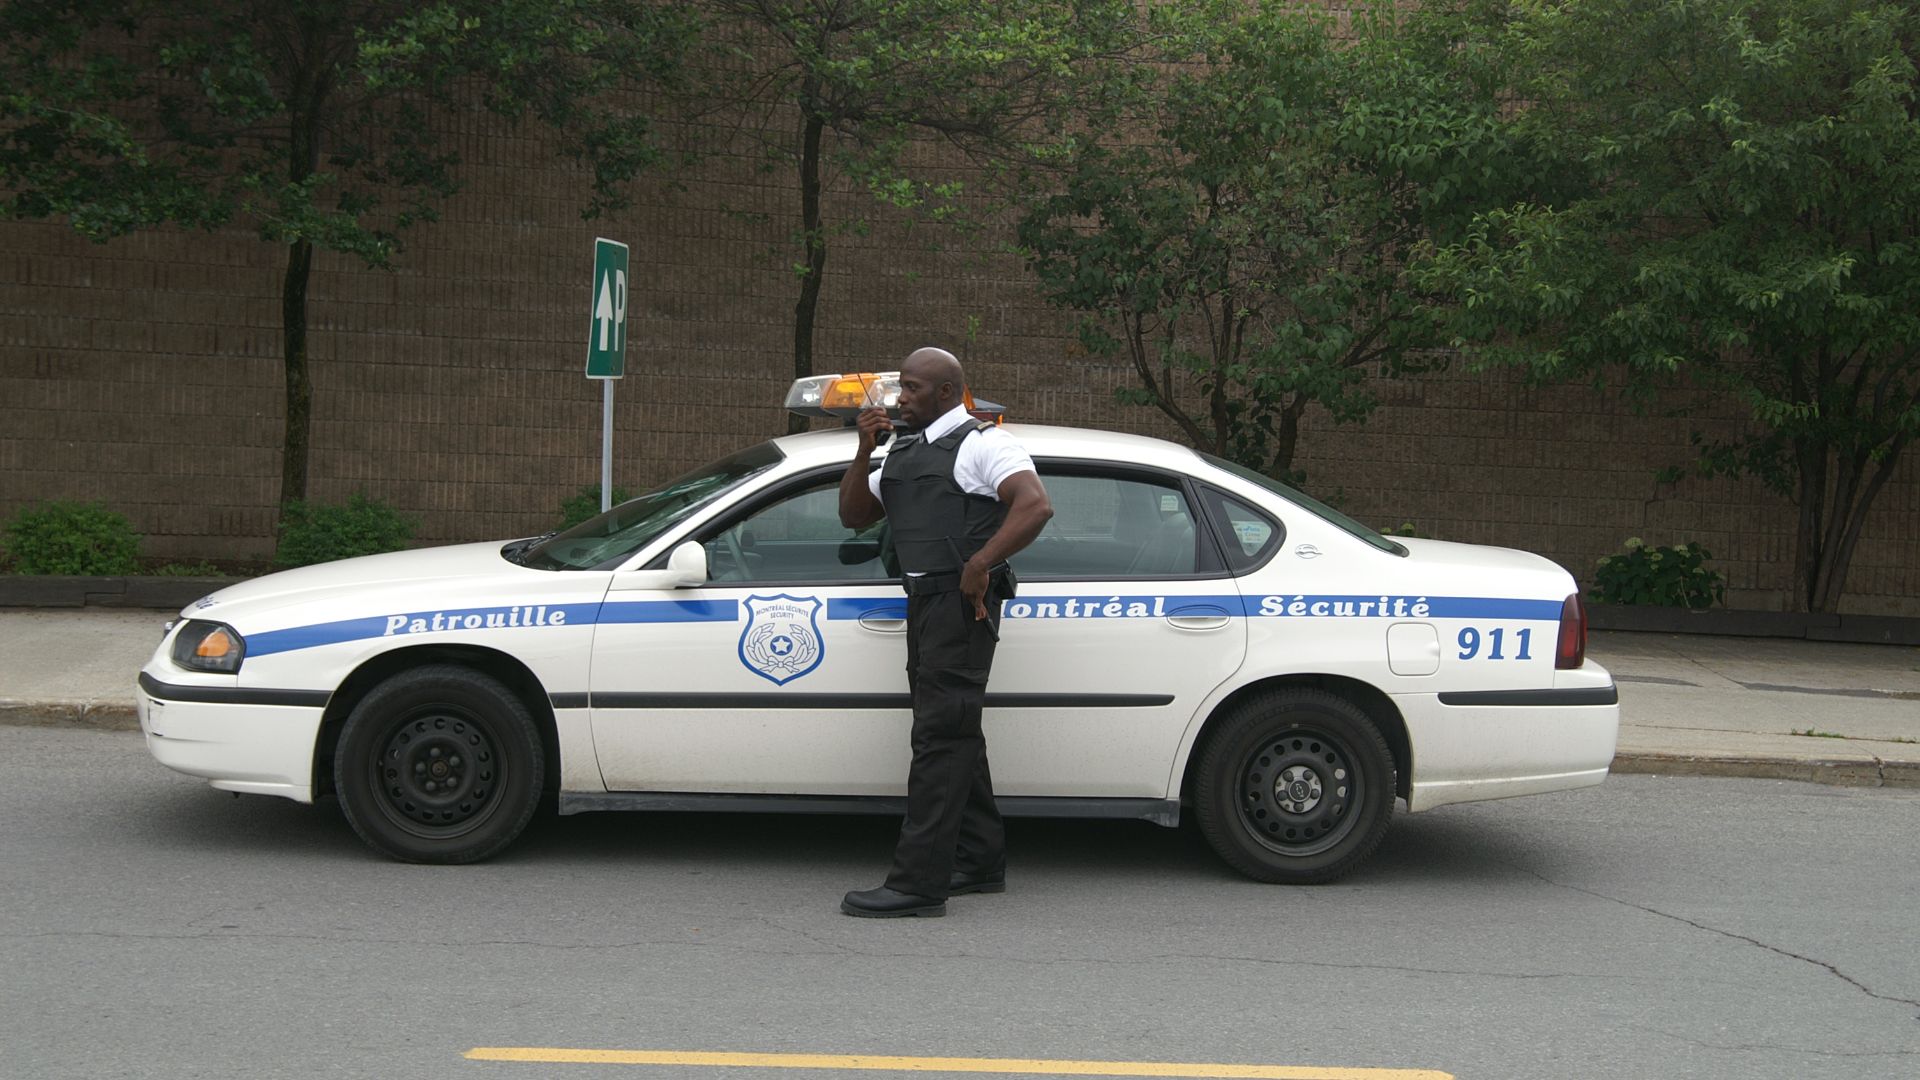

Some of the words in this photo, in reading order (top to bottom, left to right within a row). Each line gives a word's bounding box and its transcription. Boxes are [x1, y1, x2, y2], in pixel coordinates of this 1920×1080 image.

[615, 269, 626, 352] P
[383, 606, 566, 636] Patrouille
[1259, 595, 1430, 618] Sécurité
[1457, 627, 1532, 660] 911
